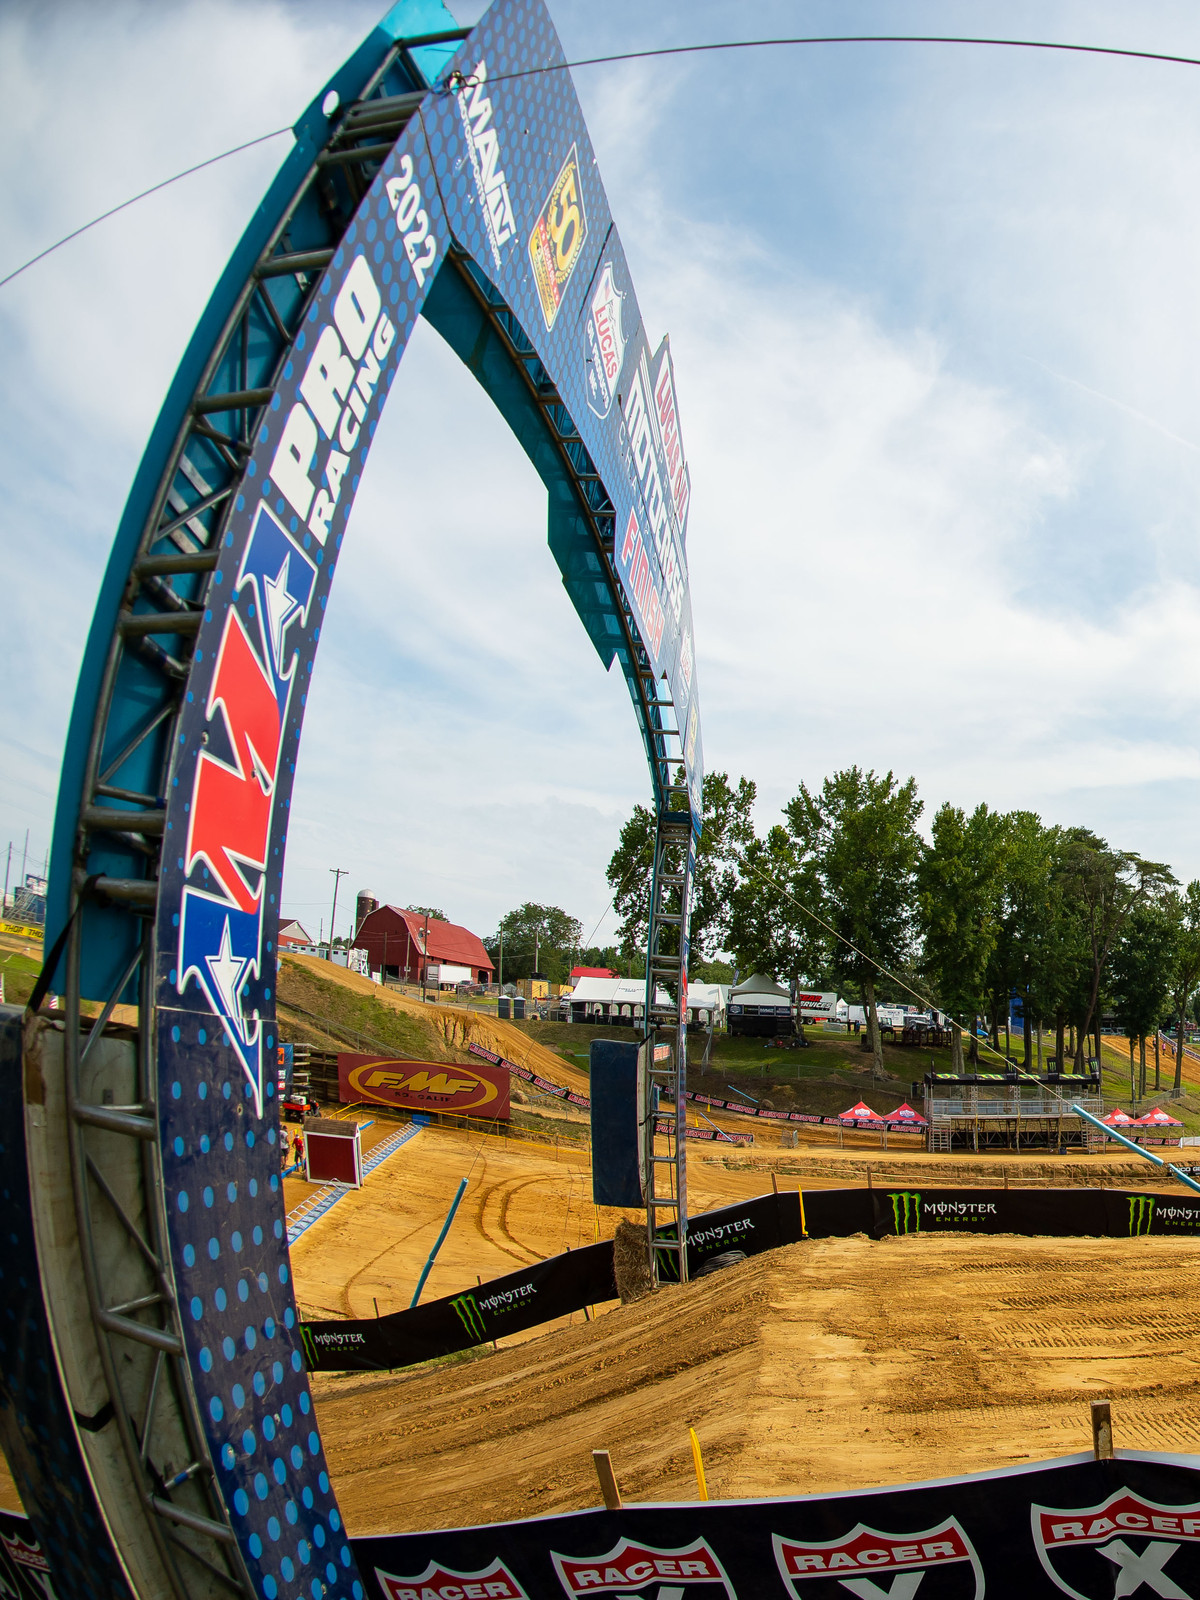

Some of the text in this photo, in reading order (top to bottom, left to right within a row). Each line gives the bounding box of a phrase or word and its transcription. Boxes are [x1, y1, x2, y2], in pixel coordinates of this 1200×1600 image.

[386, 154, 437, 288] 2022
[594, 305, 618, 380] LUCAS
[269, 255, 382, 522] PRO
[307, 312, 397, 547] RACING
[656, 368, 689, 530] LUCAS OIL
[621, 505, 666, 662] FINISH
[4, 924, 24, 935] THOR
[363, 1070, 481, 1096] FMF
[923, 1202, 998, 1215] MONSTER
[683, 1218, 755, 1248] MONSTER
[697, 1234, 748, 1253] ENERGY
[477, 1283, 538, 1311] MONSTER
[493, 1298, 533, 1317] ENERGY
[314, 1332, 366, 1346] MONSTER
[793, 1540, 956, 1572] RACER
[1094, 1539, 1196, 1600] X
[573, 1560, 709, 1587] RACER
[395, 1581, 511, 1600] RACER
